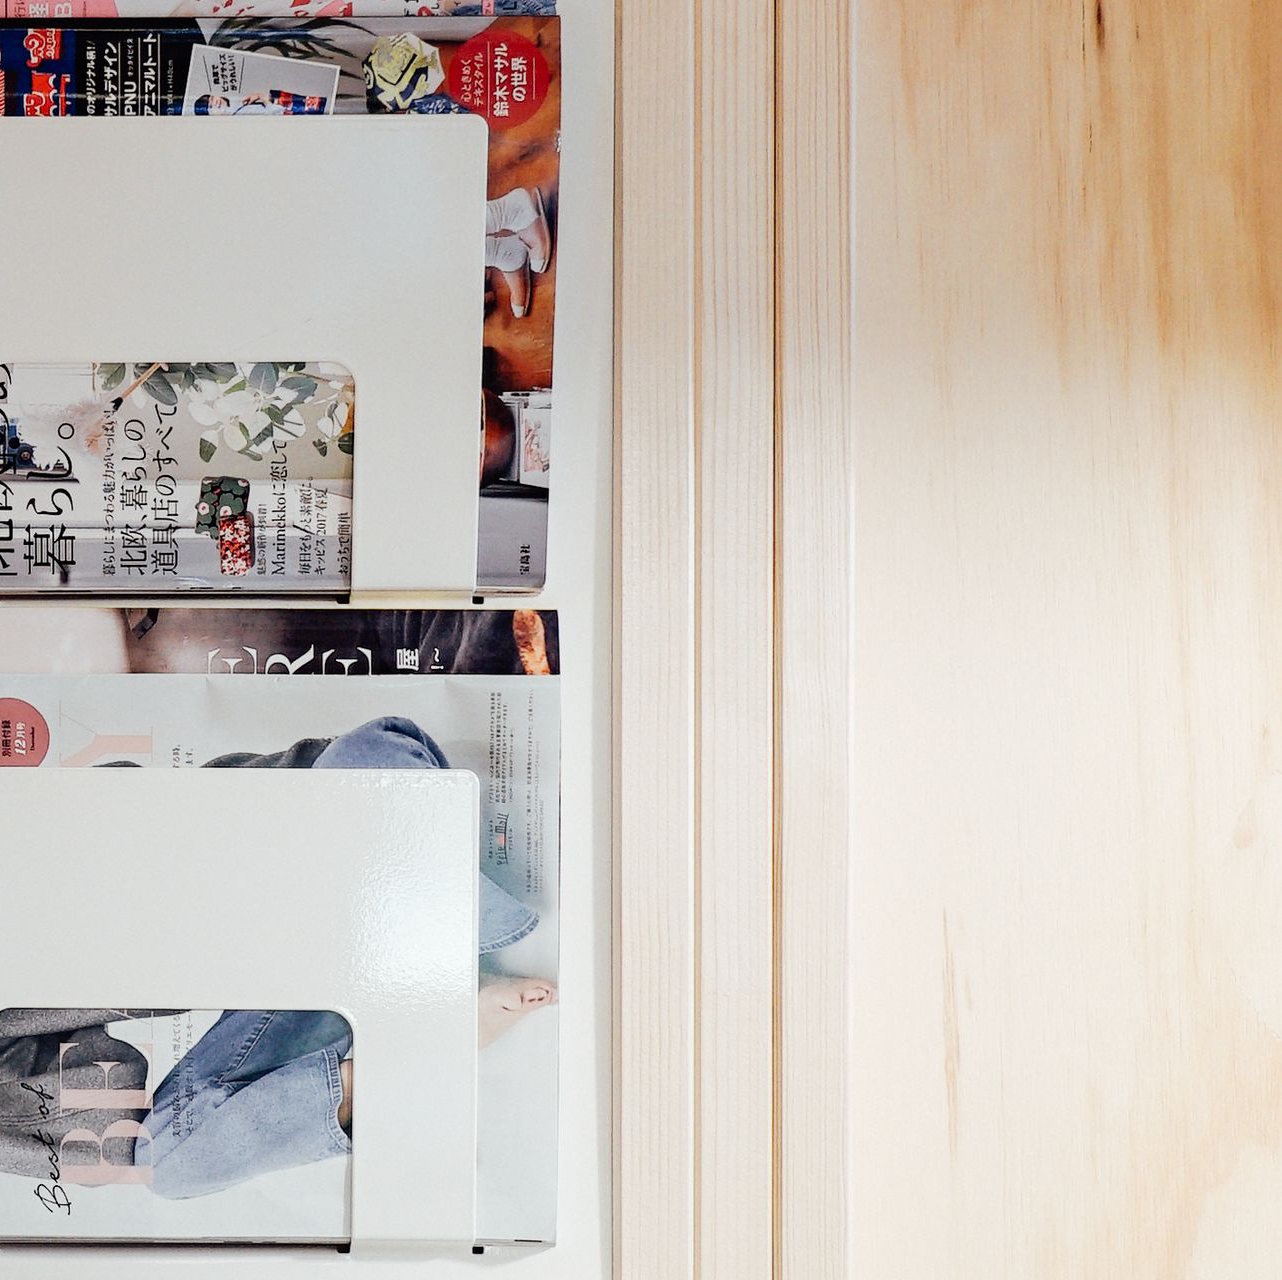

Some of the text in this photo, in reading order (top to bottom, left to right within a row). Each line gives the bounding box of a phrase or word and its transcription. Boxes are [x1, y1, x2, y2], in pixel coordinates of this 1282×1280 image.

[460, 58, 473, 104] 心ときめく
[472, 52, 486, 108] テキスタイル
[491, 43, 511, 118] 鈴木マサル
[509, 55, 529, 103] の世界
[23, 422, 76, 576] 暮らし。
[120, 419, 149, 577] 北欧、暮らしの
[150, 402, 179, 577] 道具店のすべて
[270, 440, 289, 577] Marimekkoに恋して
[20, 1082, 72, 1216] Best of
